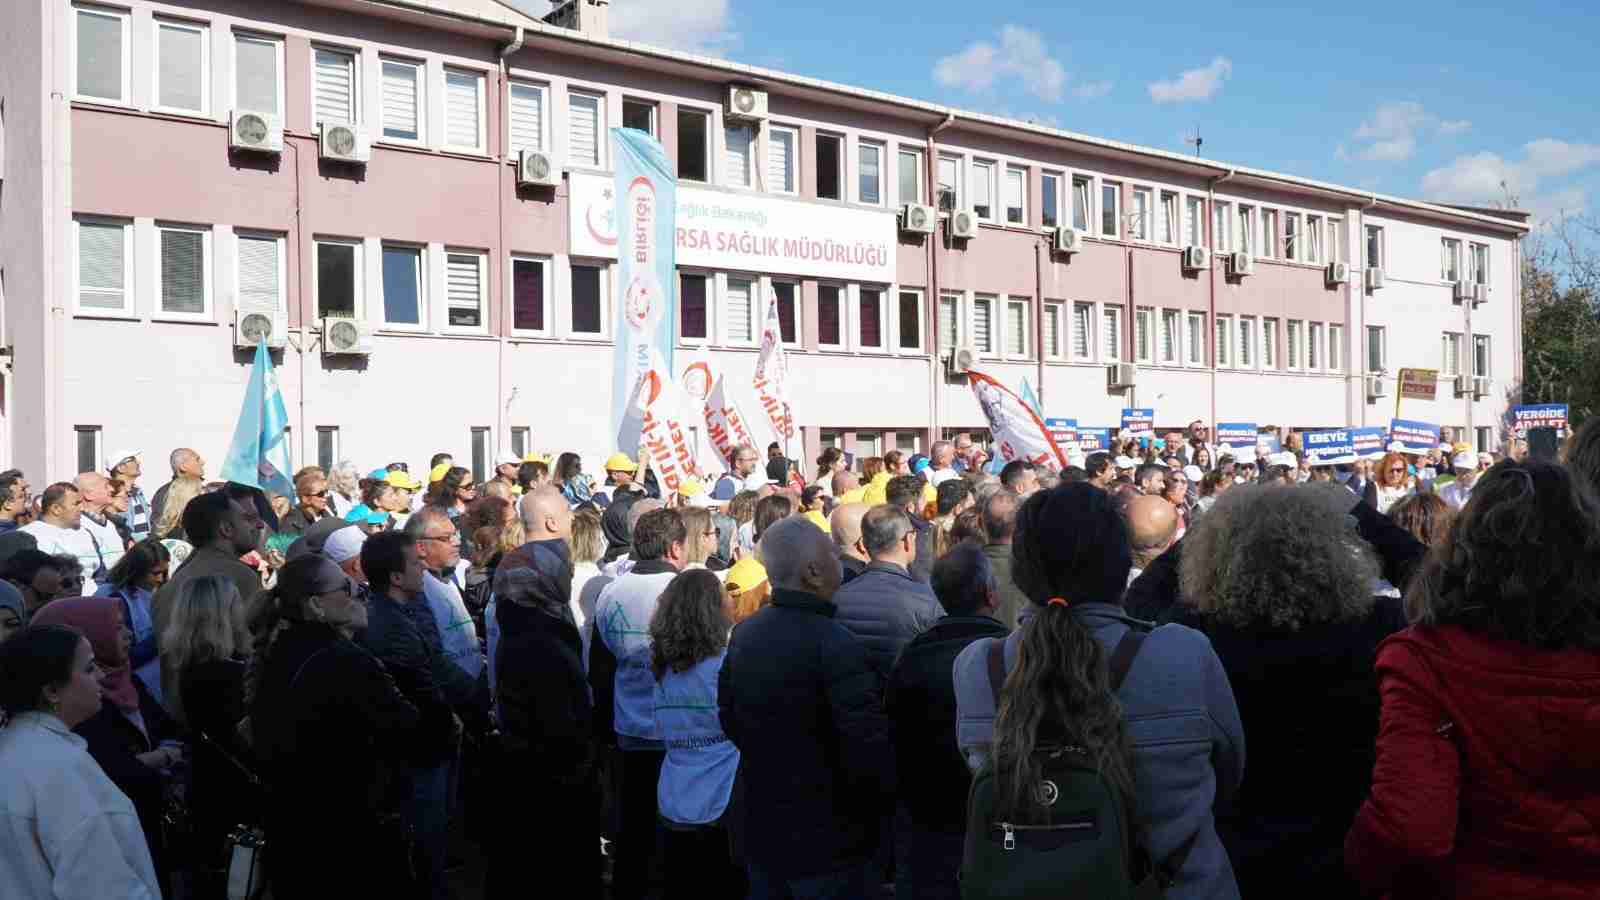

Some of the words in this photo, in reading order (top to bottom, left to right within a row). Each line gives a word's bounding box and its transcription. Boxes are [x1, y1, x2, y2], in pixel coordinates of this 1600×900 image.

[676, 226, 712, 250] RSA
[717, 229, 779, 257] SAĞLIK
[783, 236, 889, 268] MÜDÜRLÜĞÜ
[1515, 407, 1566, 420] VERGİDE
[1308, 430, 1348, 444] EBEYİZ
